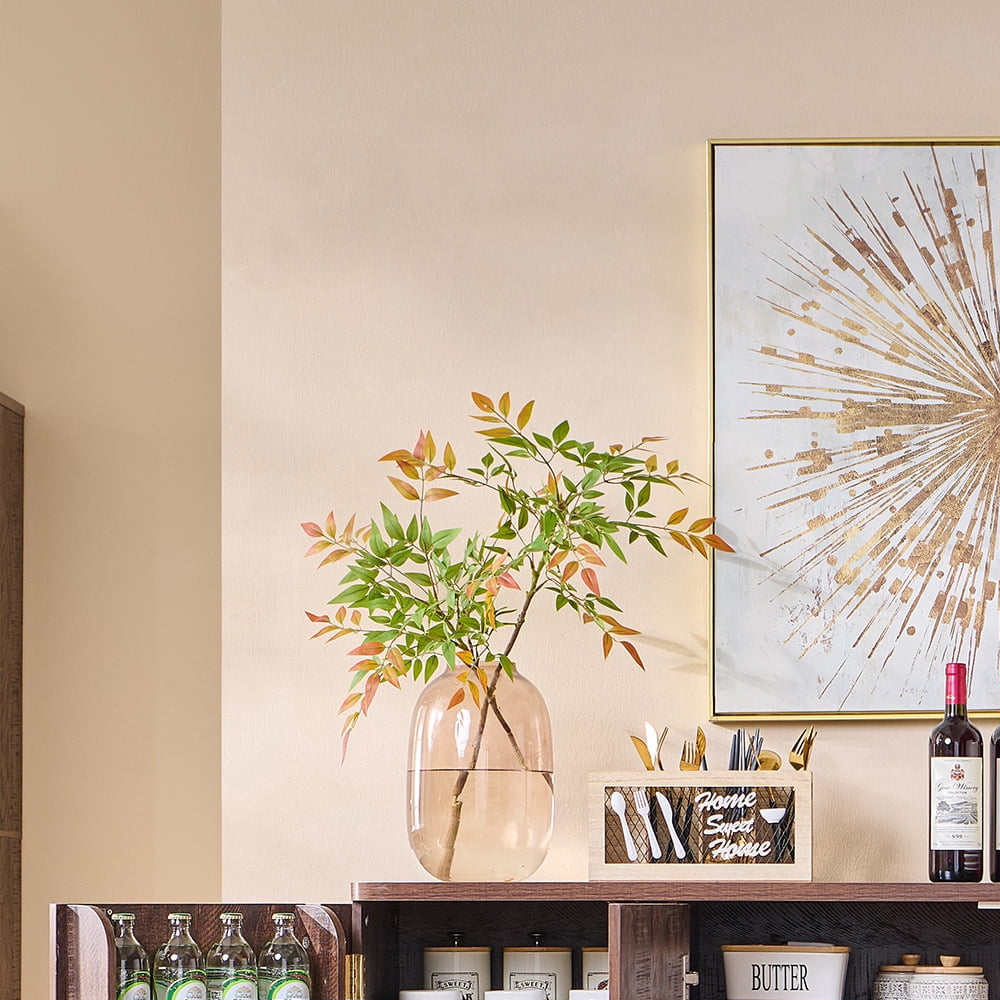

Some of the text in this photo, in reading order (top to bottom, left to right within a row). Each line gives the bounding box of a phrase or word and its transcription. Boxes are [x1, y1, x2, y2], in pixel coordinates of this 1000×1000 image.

[694, 791, 757, 811] Home
[703, 814, 755, 835] Sweet
[708, 838, 772, 860] Home
[751, 963, 810, 991] BUTTER
